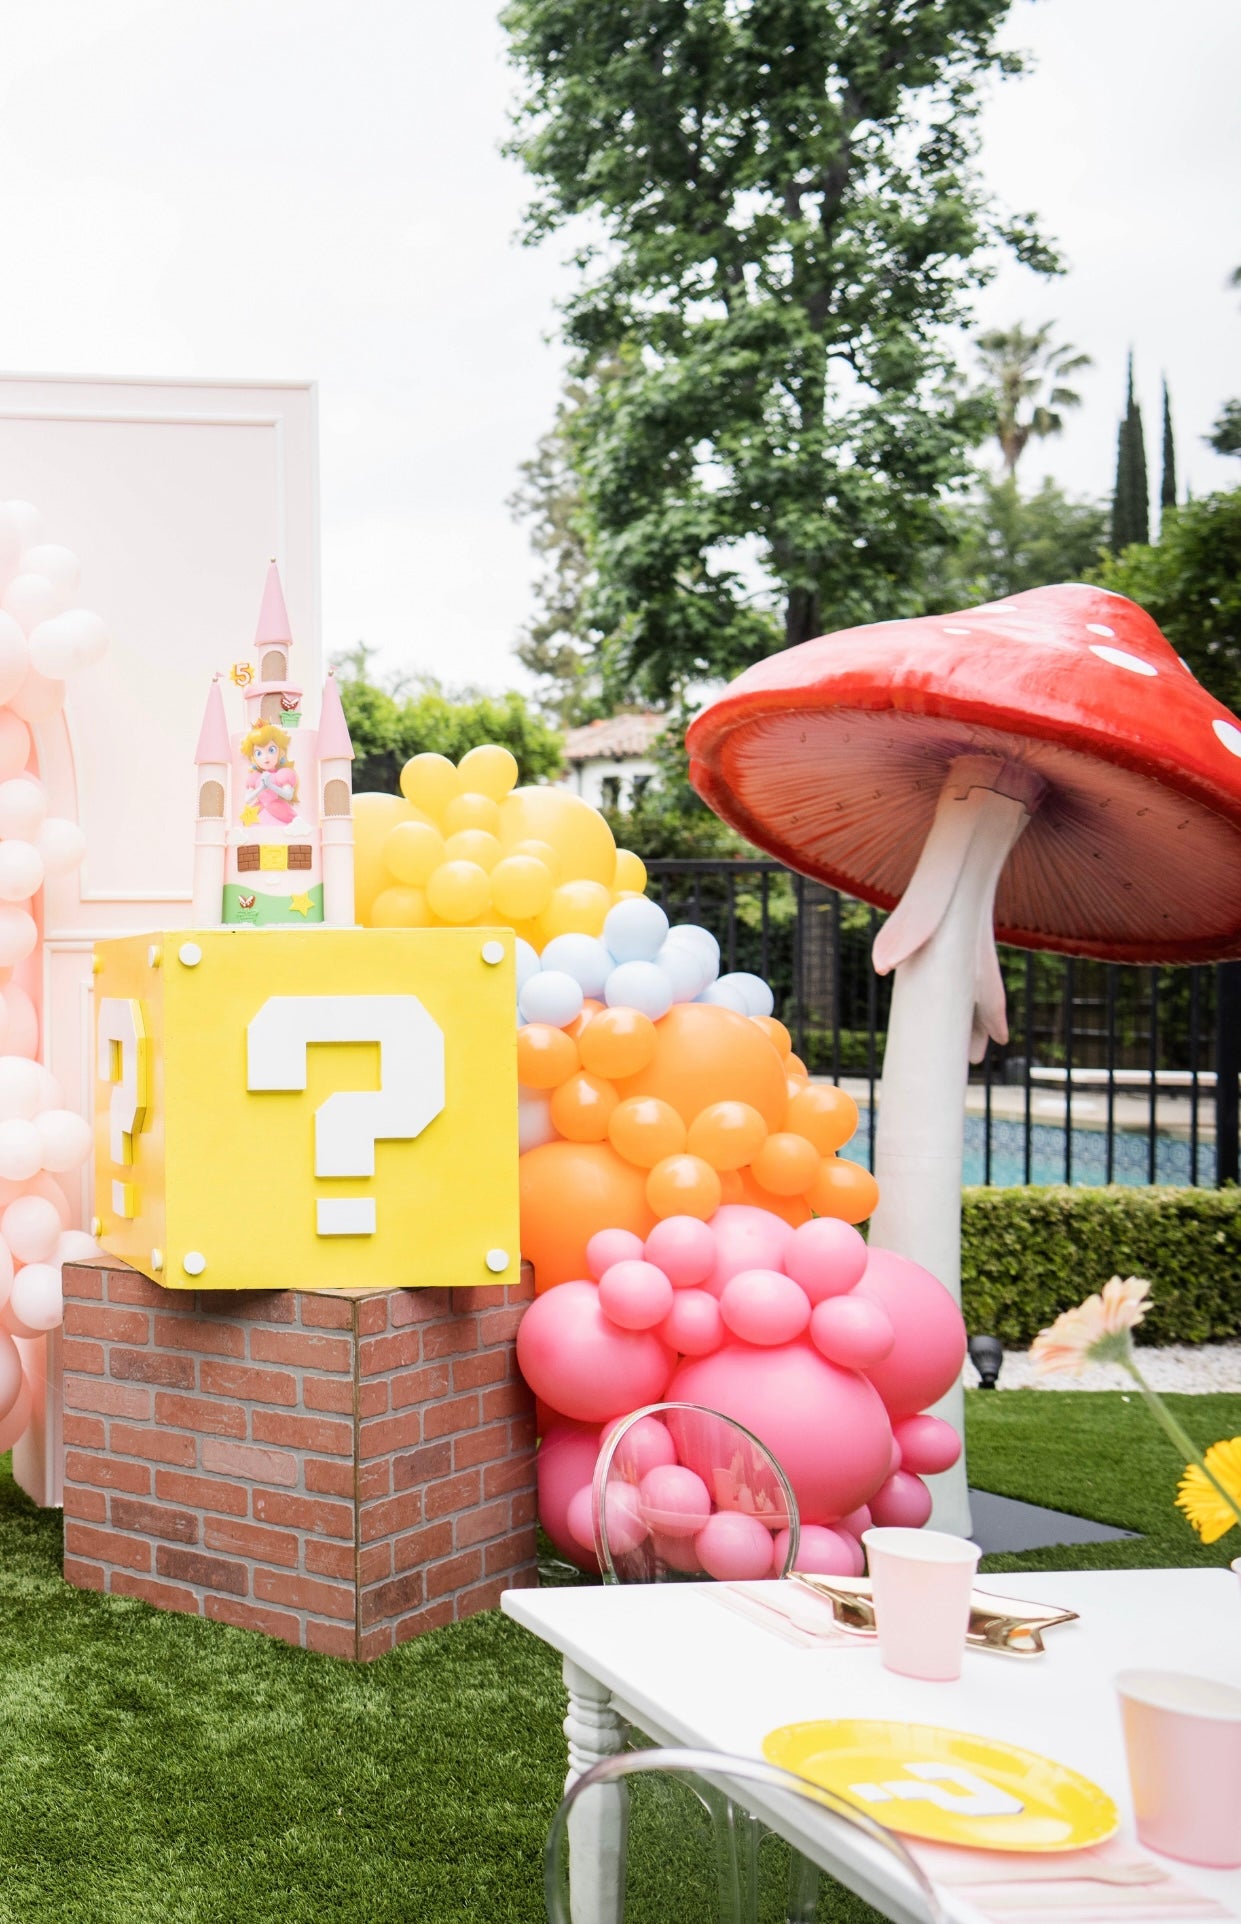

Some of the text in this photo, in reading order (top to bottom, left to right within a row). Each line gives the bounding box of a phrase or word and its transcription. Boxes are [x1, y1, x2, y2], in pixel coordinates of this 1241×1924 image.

[234, 663, 252, 687] 5
[246, 995, 446, 1236] ?
[849, 1762, 1024, 1815] ?
